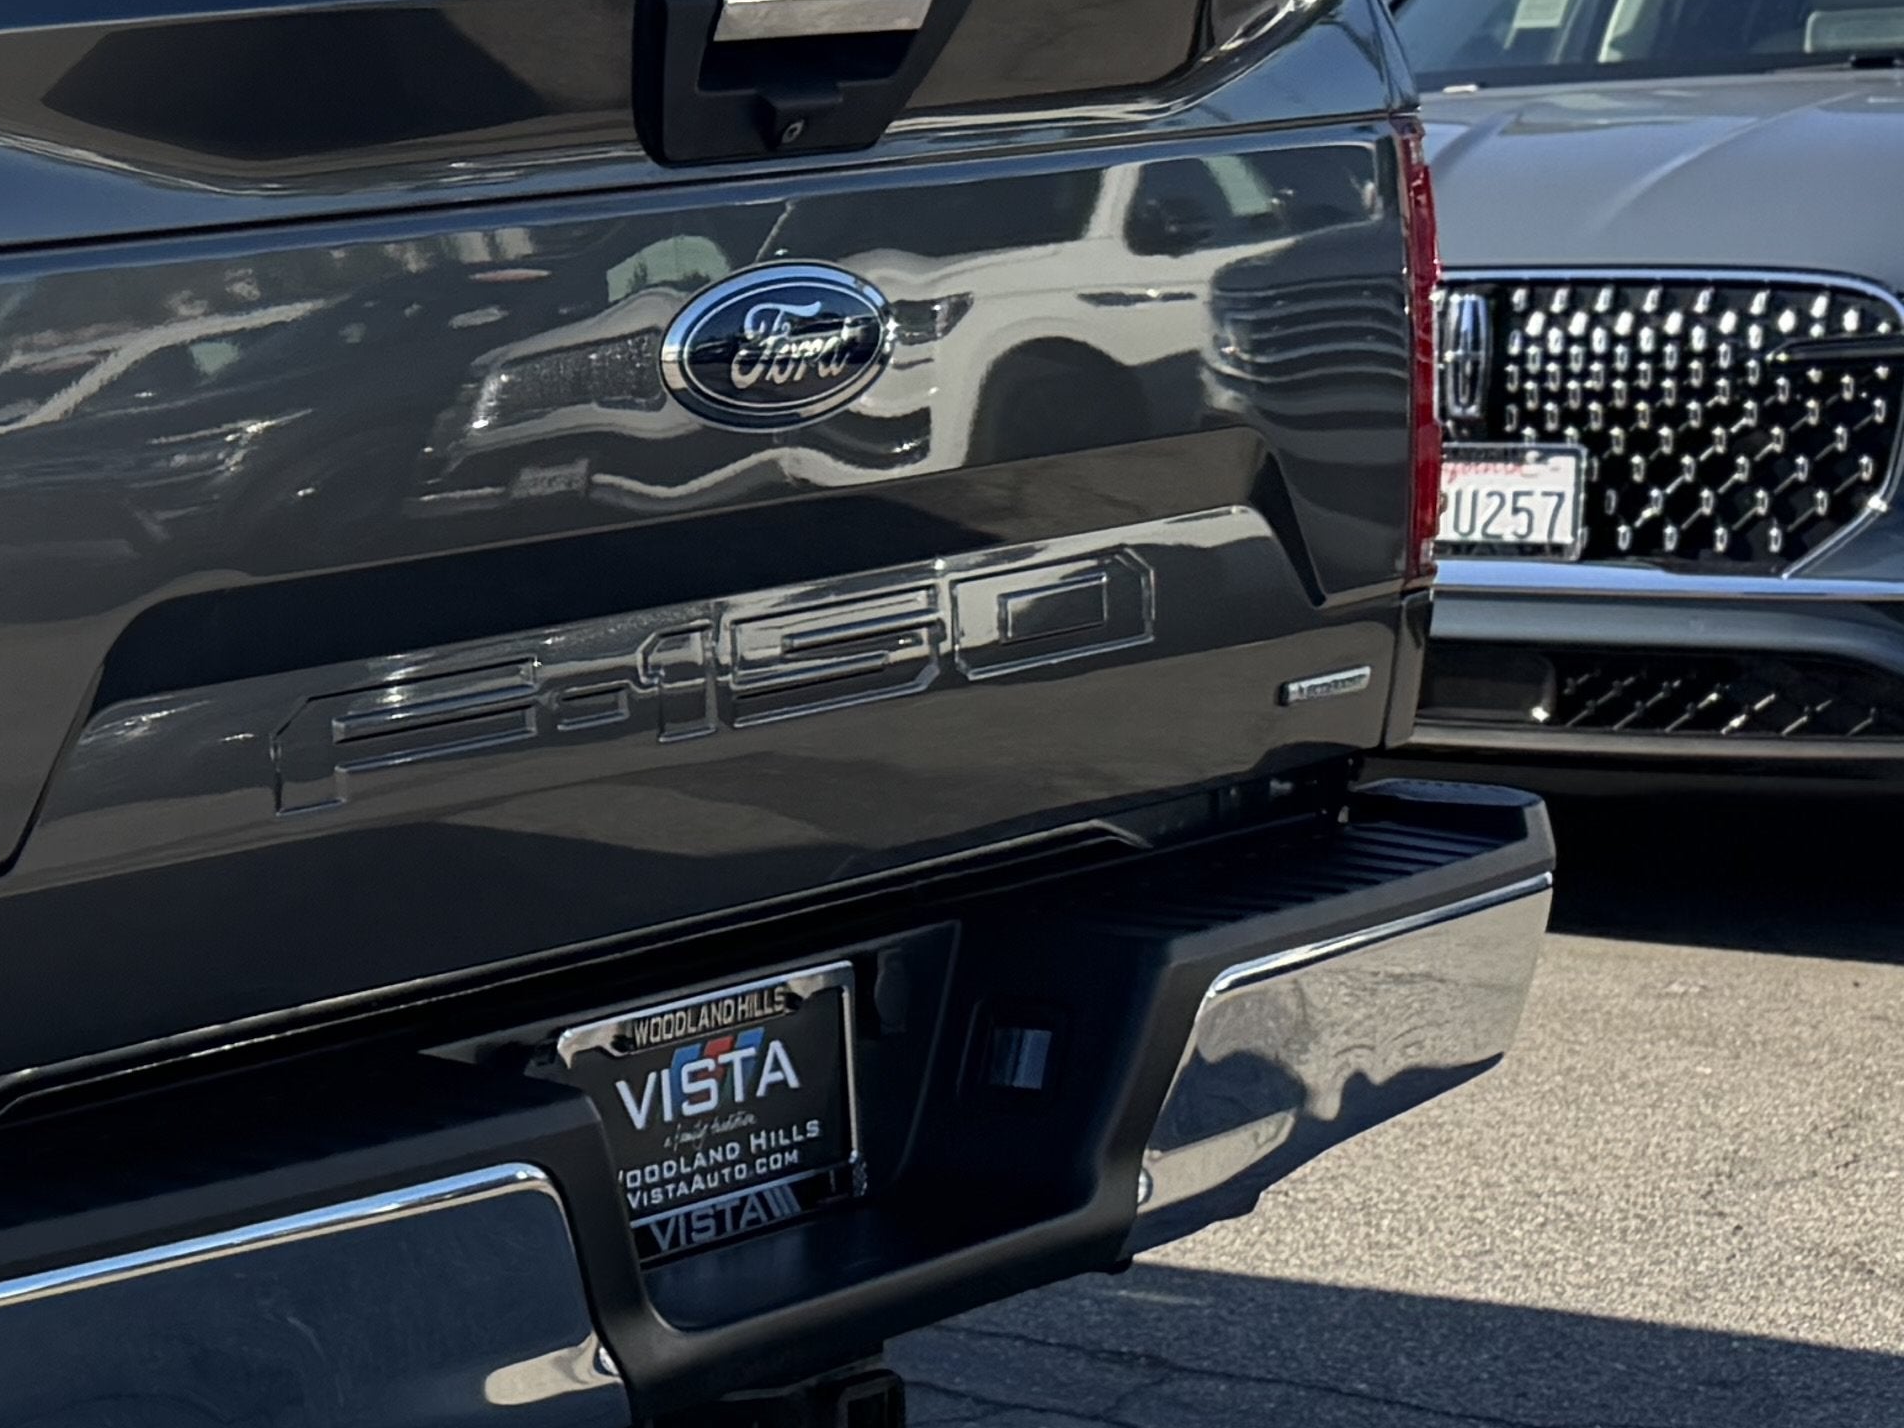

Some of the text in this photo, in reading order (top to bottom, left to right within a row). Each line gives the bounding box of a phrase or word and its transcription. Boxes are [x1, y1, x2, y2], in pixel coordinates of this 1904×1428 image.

[730, 300, 852, 390] Ford
[634, 985, 786, 1047] WOODLAND HILLS
[615, 1039, 800, 1130] VISTA
[750, 1119, 820, 1154] HILLS
[650, 1191, 769, 1252] VISTA
